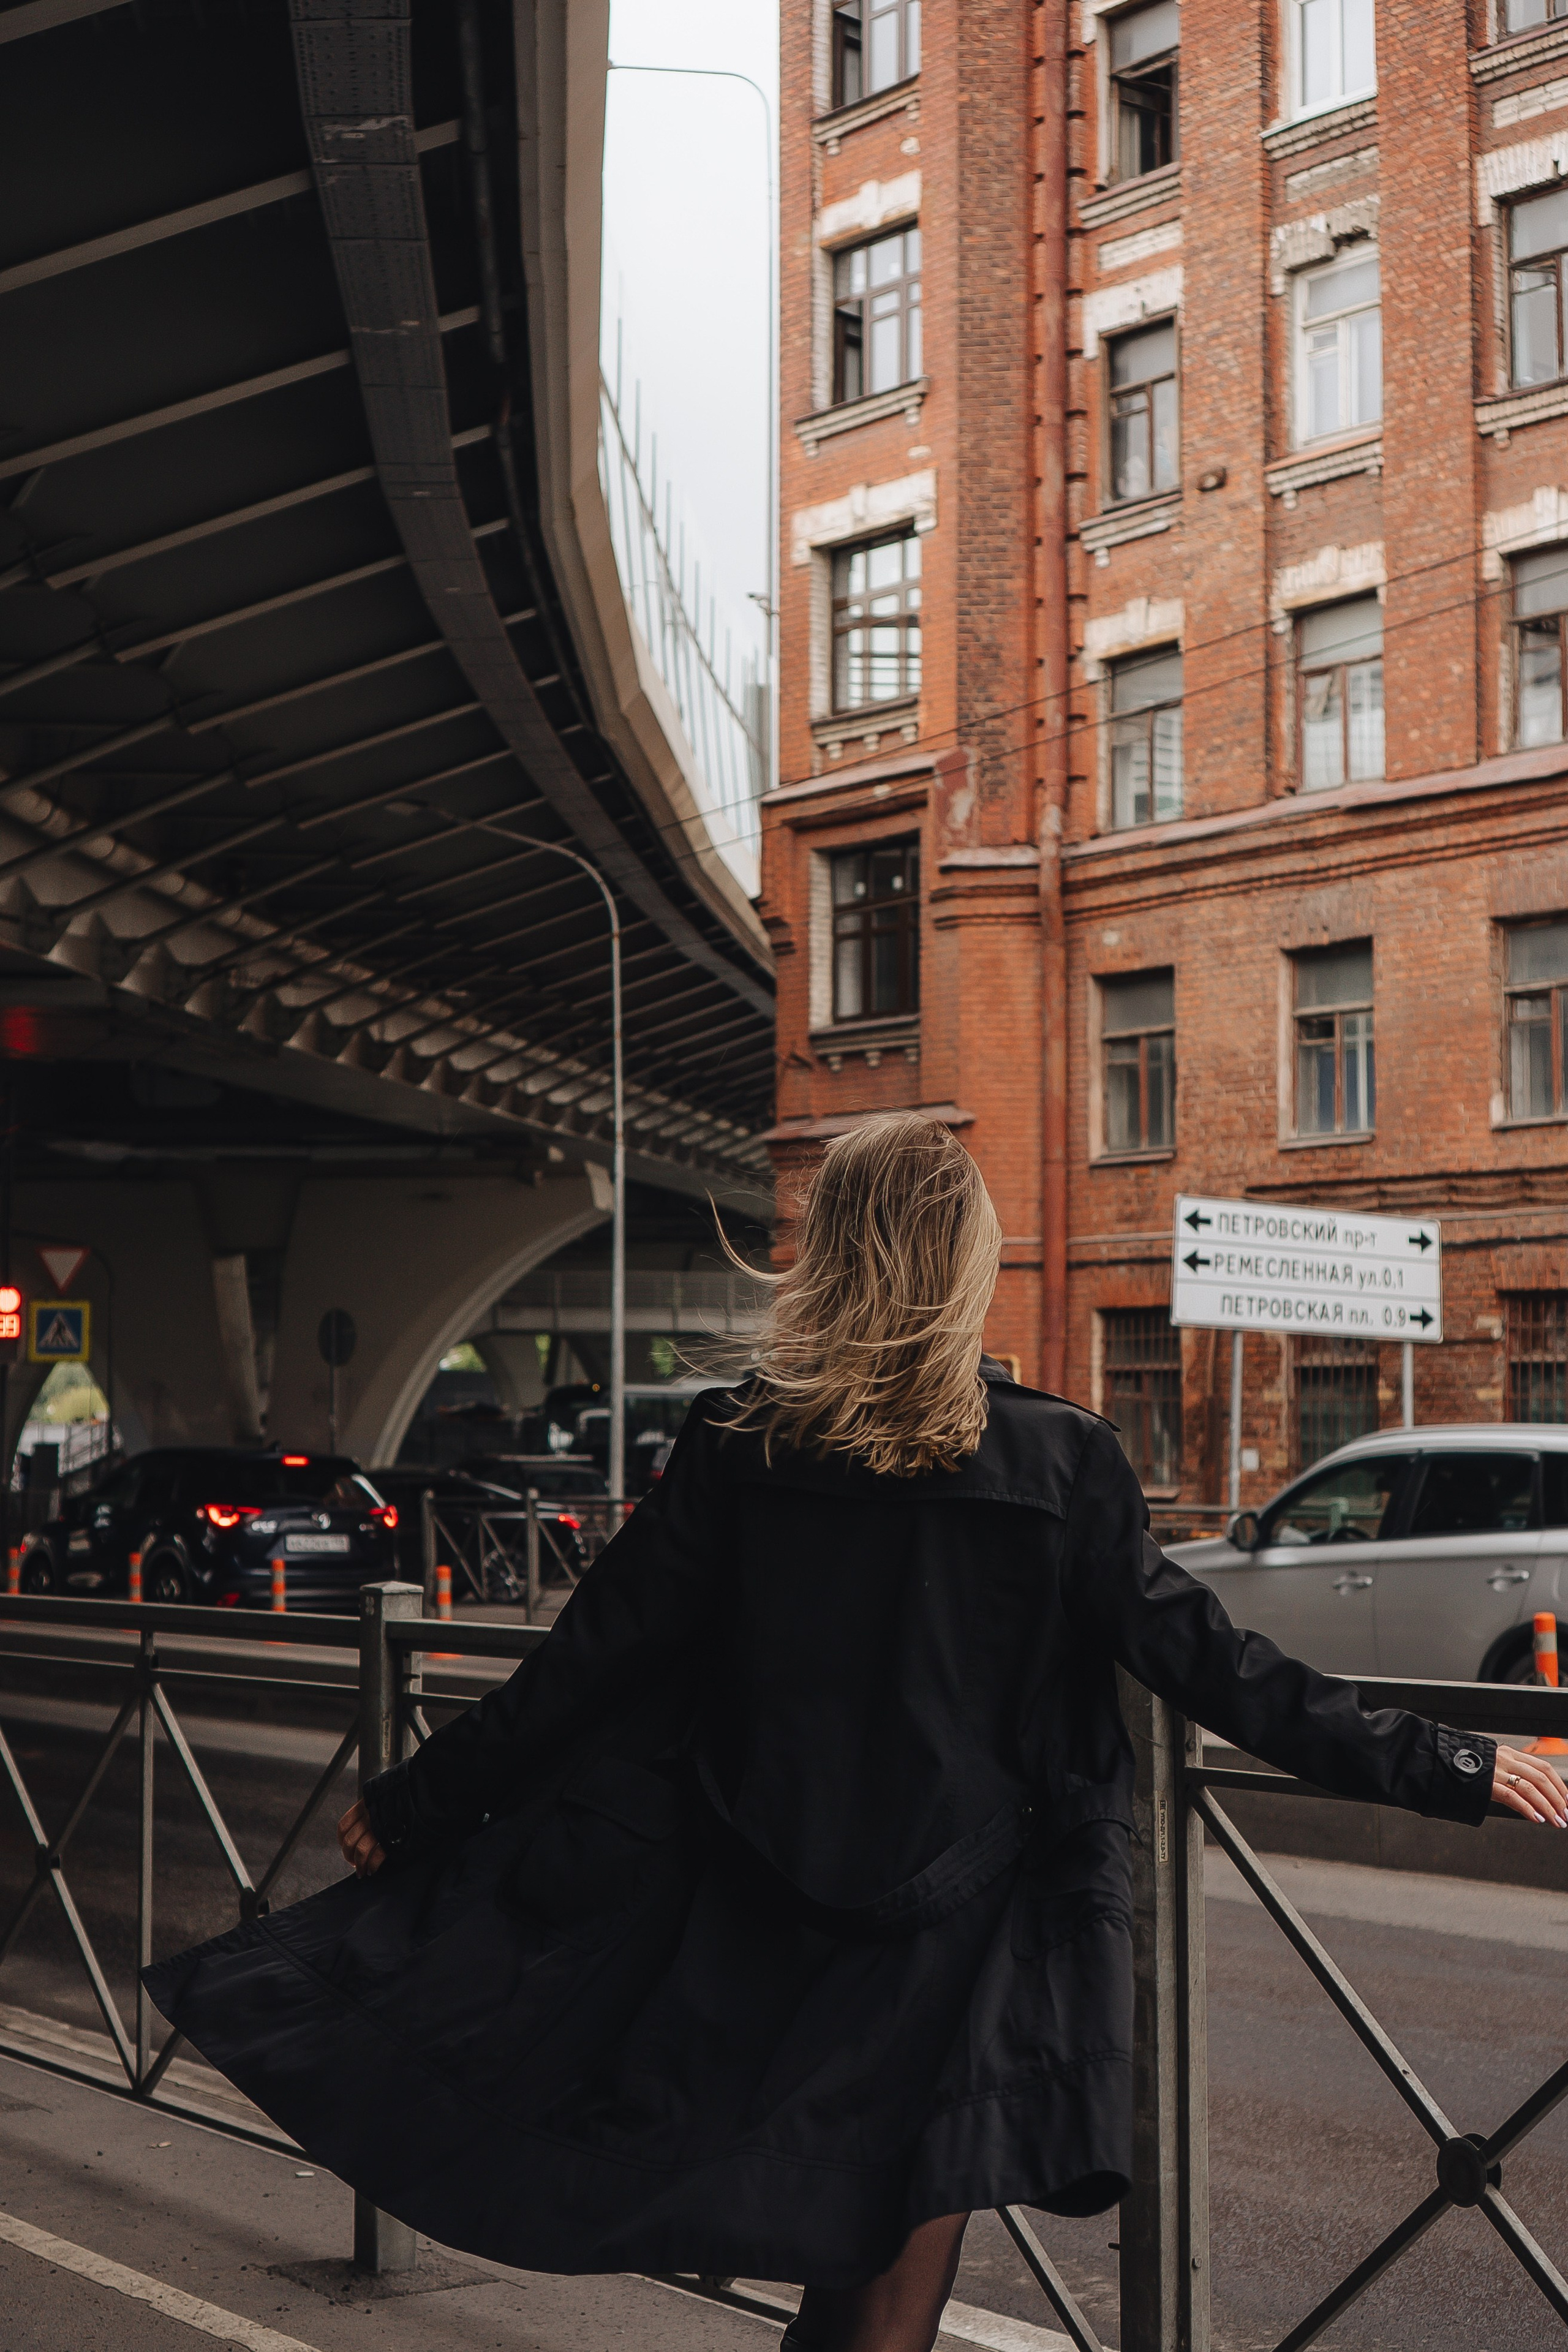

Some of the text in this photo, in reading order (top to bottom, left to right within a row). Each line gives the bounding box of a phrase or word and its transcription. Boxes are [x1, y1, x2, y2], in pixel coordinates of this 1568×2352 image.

[1218, 1213, 1378, 1250] ПЕТРОВСКИЙ пр-т
[1214, 1253, 1352, 1284] РЕМЕСЛЕННАЯ
[1221, 1294, 1344, 1324] ПЕТРОВСКАЯ
